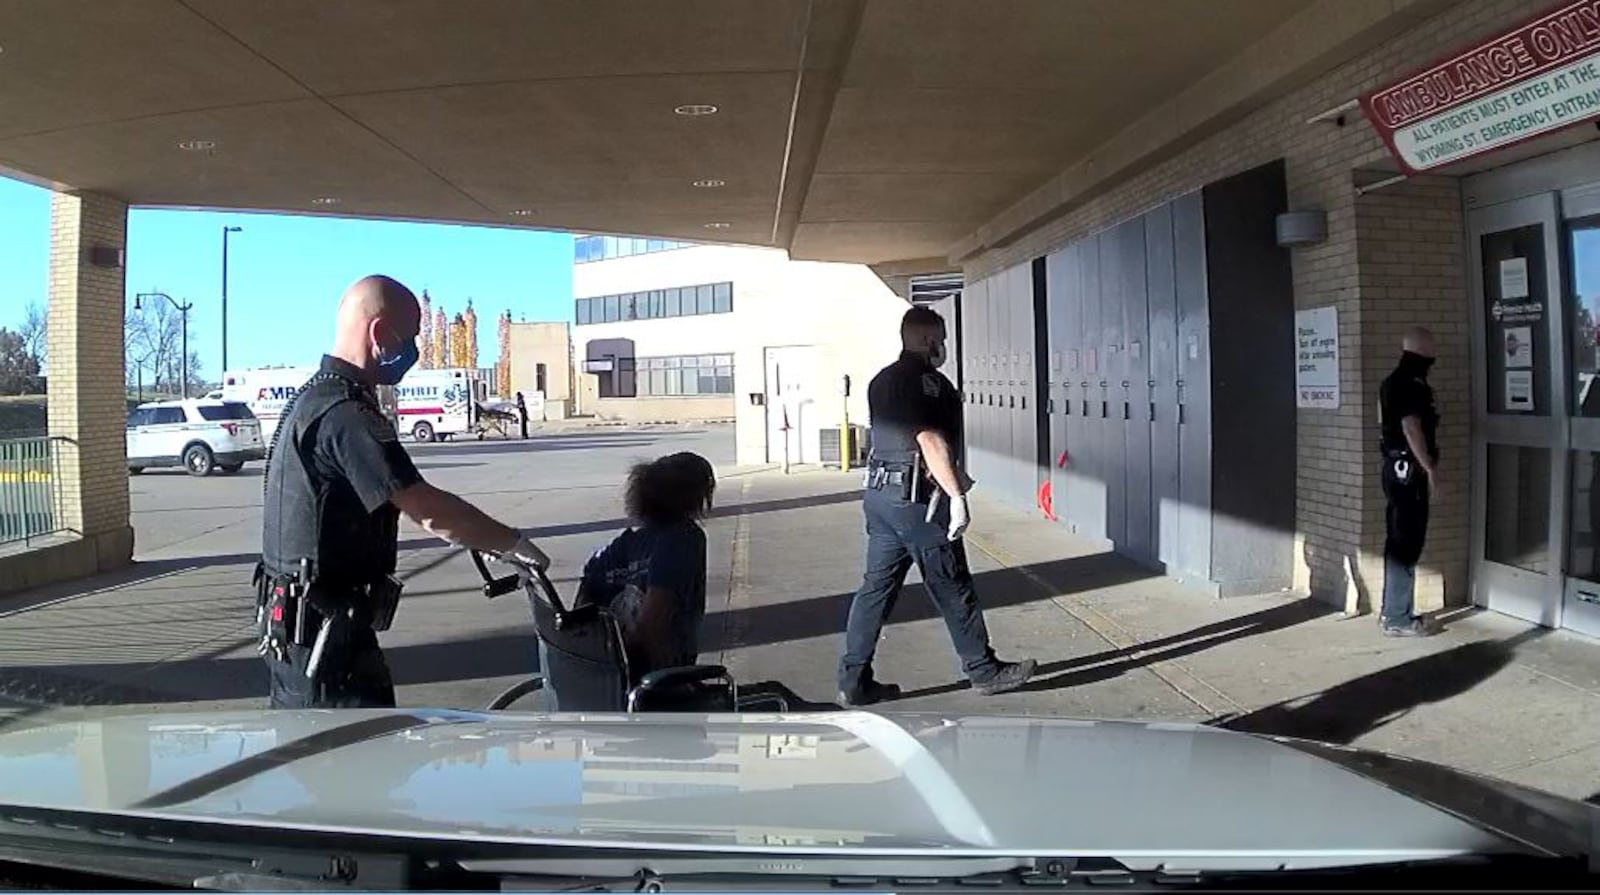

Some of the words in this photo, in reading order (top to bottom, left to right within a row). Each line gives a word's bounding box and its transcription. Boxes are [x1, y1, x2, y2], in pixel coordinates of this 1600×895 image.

[1384, 37, 1537, 125] AMBULANCE
[1412, 126, 1430, 144] ALL
[1432, 109, 1479, 137] PATIENTS
[1480, 97, 1511, 118] MUST
[1511, 83, 1554, 106] ENTER
[1556, 75, 1572, 91] AT
[1570, 63, 1599, 85] THE
[1414, 134, 1464, 162] WYOMING
[1482, 109, 1552, 142] EMERGENCY
[395, 386, 439, 397] SPIRIT
